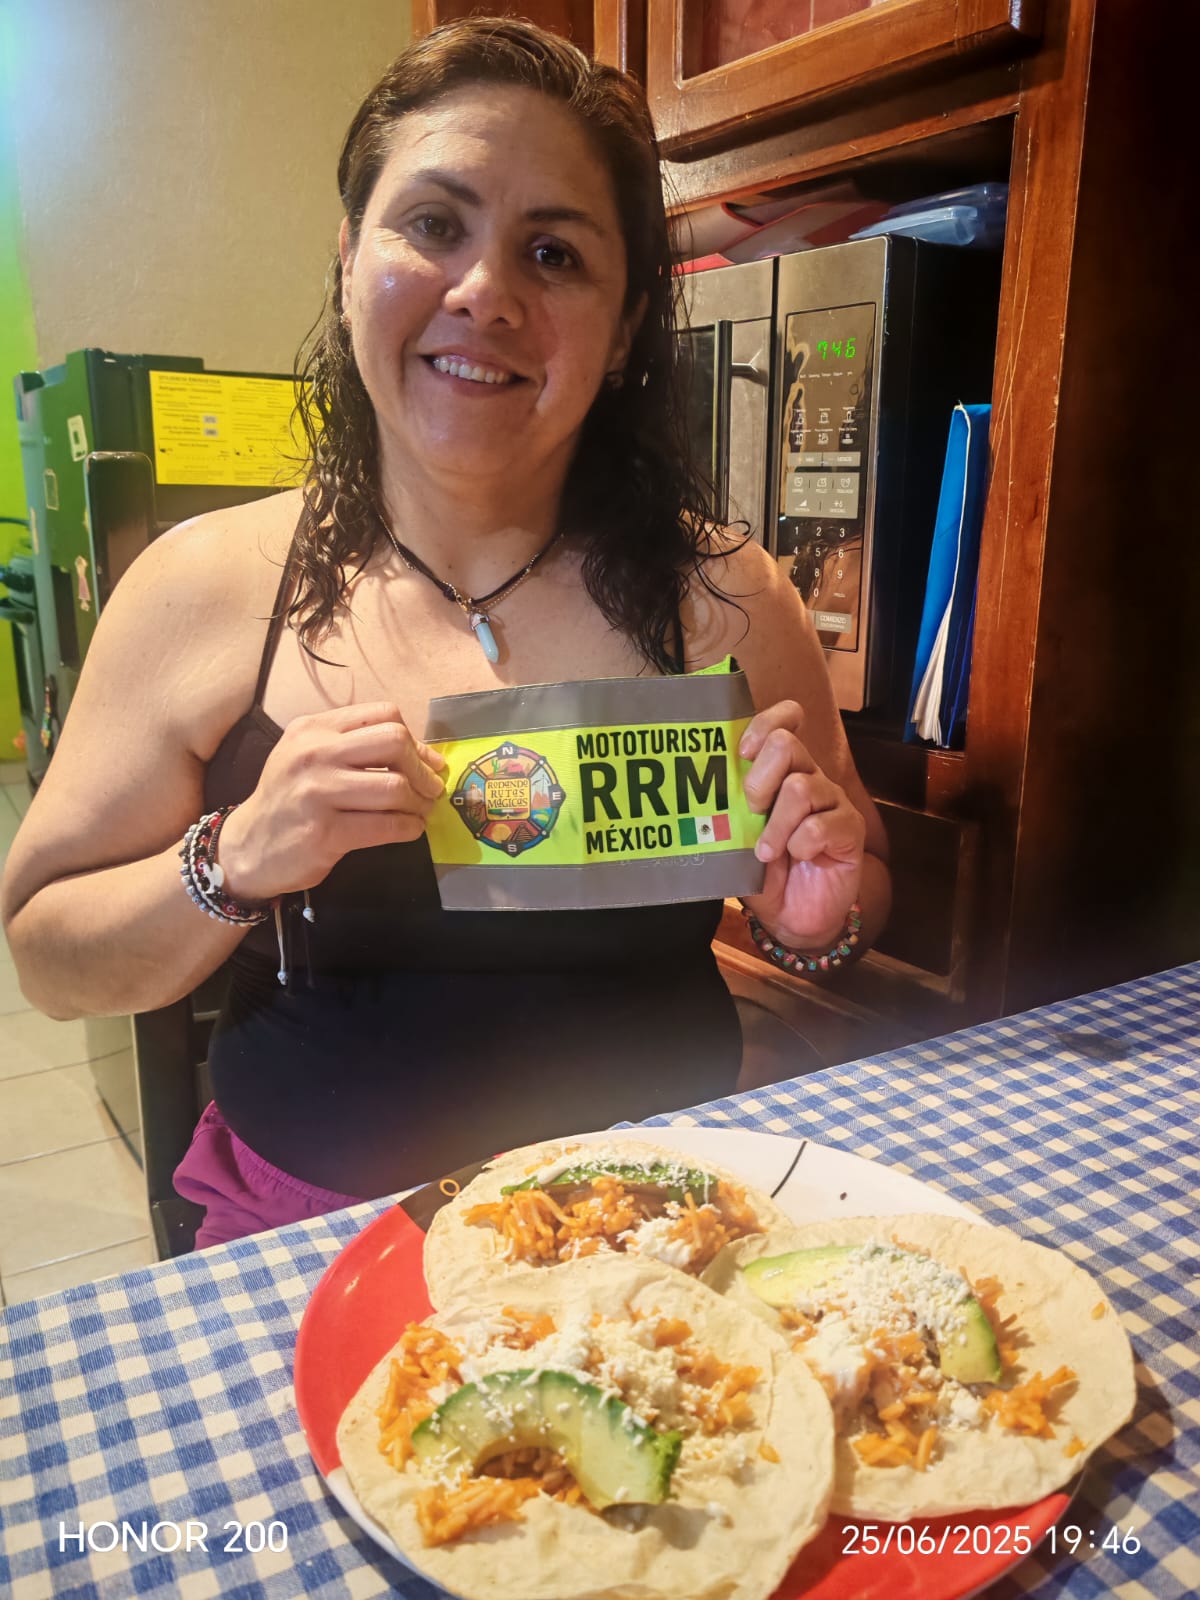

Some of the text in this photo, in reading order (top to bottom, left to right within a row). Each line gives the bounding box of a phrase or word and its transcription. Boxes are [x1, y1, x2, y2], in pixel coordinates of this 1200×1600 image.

[794, 526, 846, 538] 1 2 3
[793, 546, 844, 559] 4 5 6
[792, 566, 843, 579] 7 8 9
[813, 588, 819, 597] 0
[576, 727, 727, 759] MOTOTURISTA
[502, 746, 514, 756] N
[579, 755, 729, 823] RRM
[552, 791, 562, 801] E
[586, 824, 673, 854] MÉXICO
[507, 844, 517, 853] S
